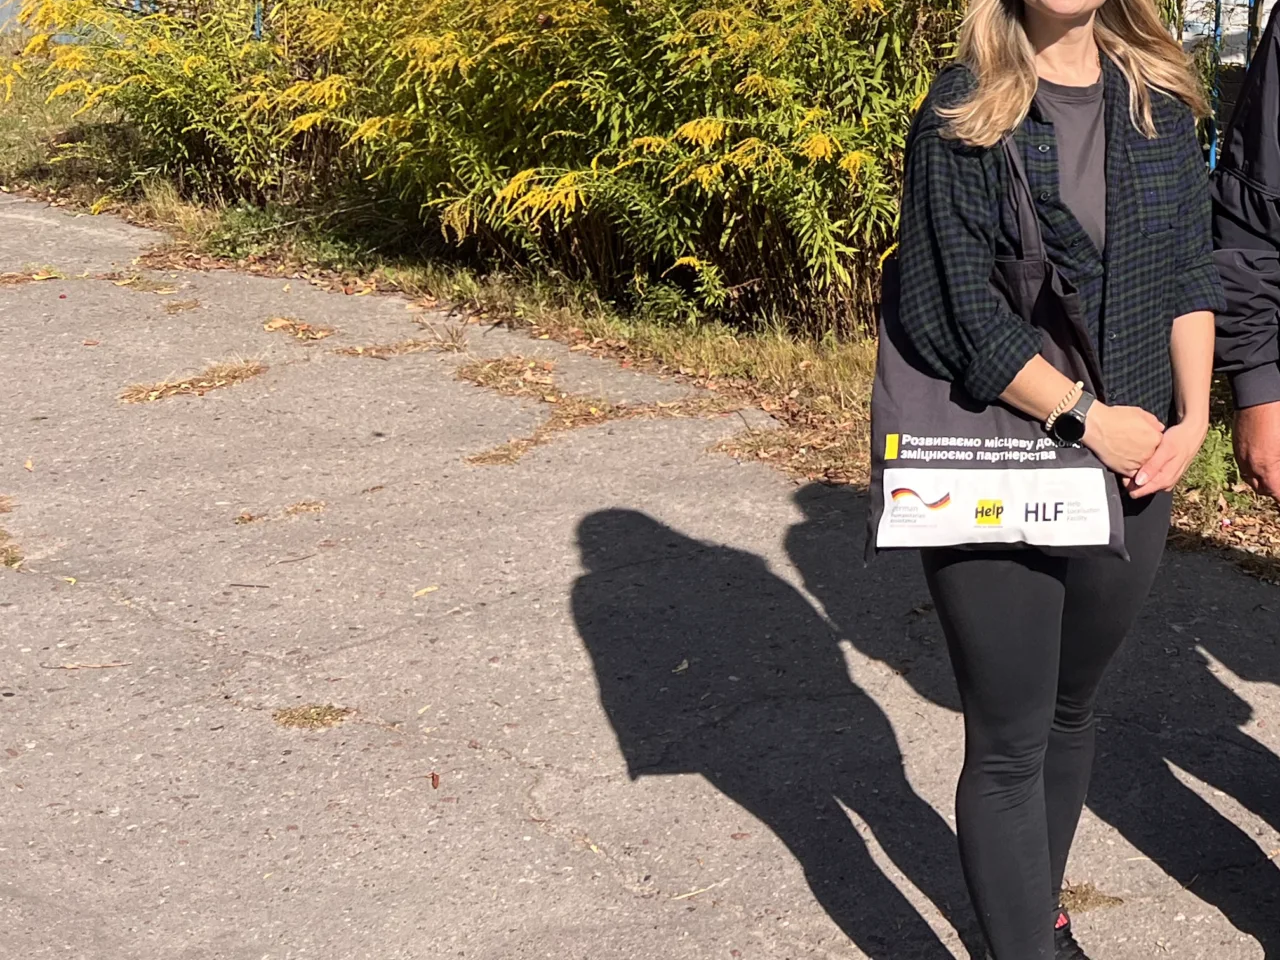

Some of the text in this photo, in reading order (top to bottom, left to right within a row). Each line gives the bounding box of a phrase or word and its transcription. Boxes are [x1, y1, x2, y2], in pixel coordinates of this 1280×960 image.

[901, 433, 982, 448] Розвиваємо
[984, 436, 1034, 450] місцеву
[900, 447, 1057, 463] зміцнюємо партнерства
[974, 503, 1005, 519] Help
[1024, 502, 1064, 522] HLF
